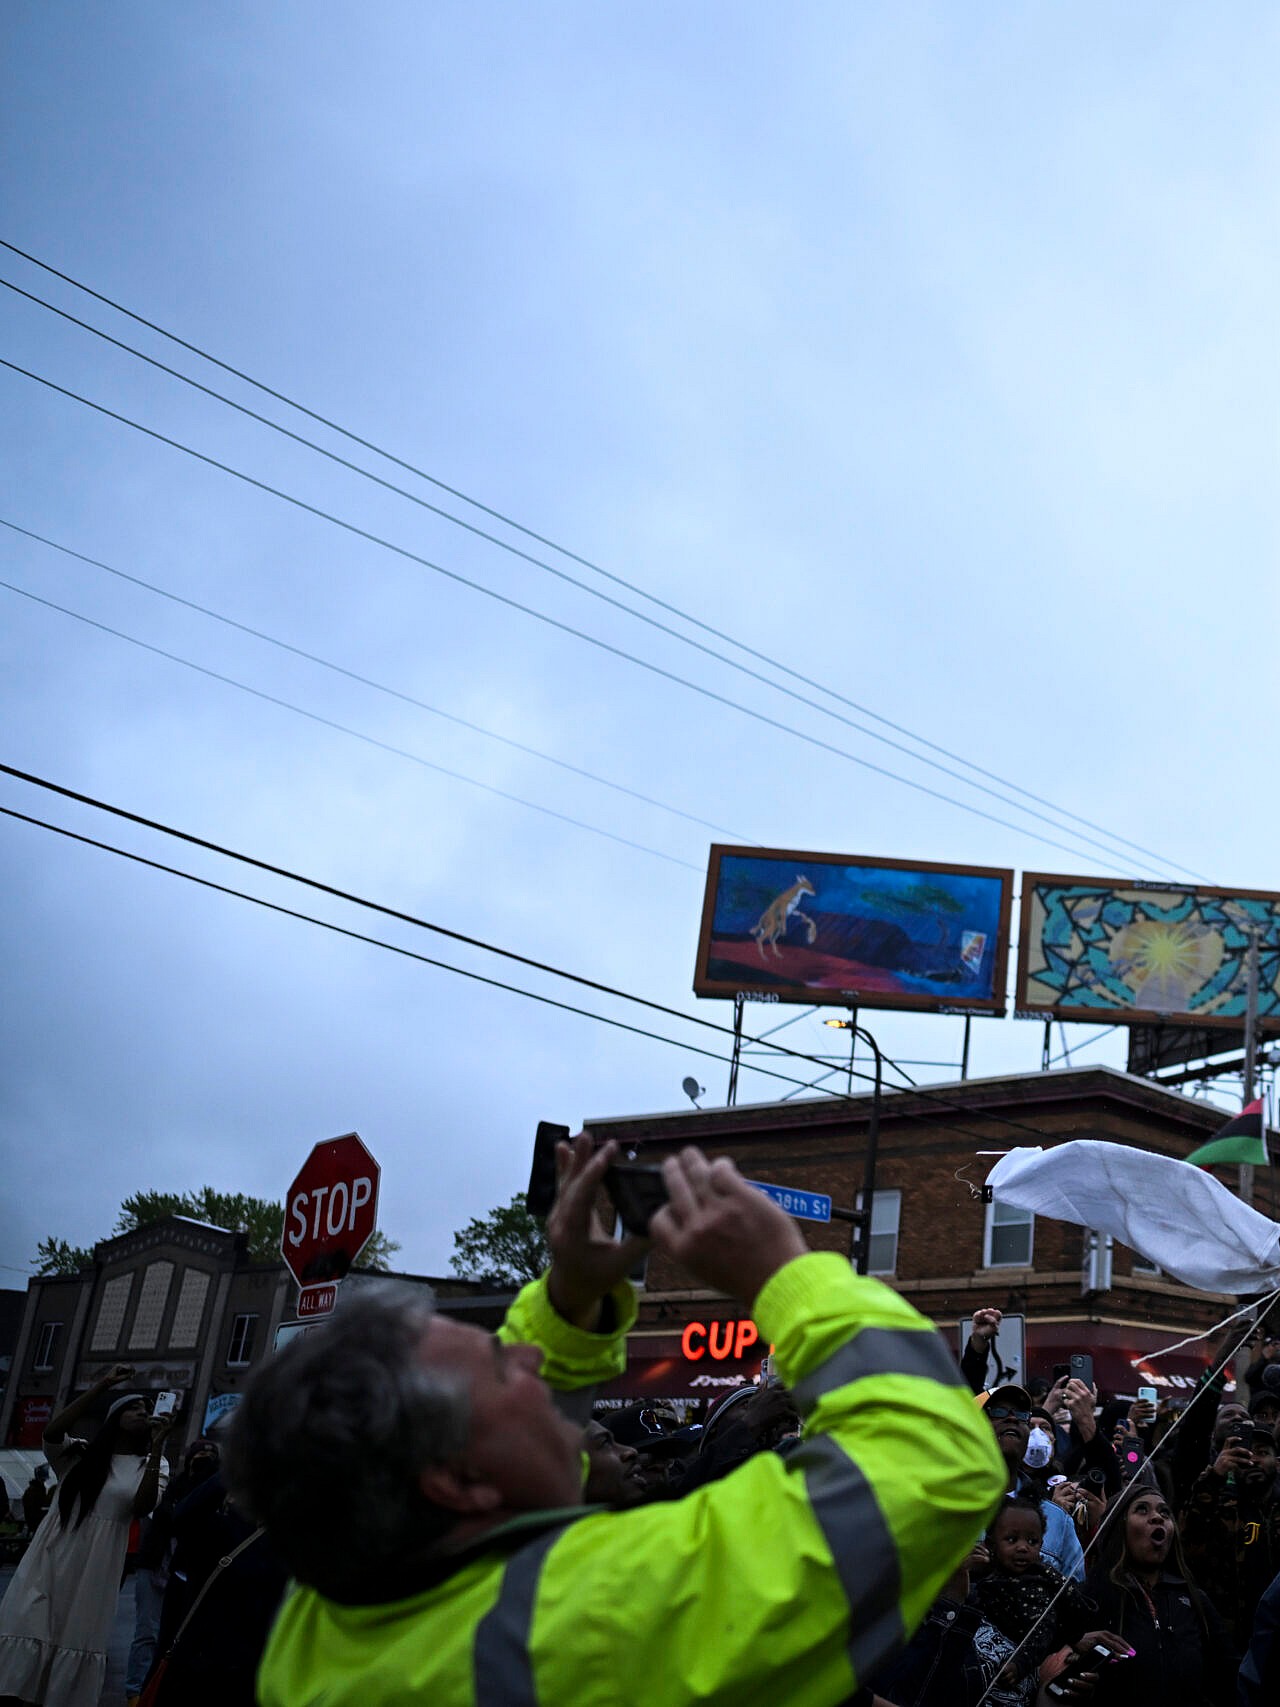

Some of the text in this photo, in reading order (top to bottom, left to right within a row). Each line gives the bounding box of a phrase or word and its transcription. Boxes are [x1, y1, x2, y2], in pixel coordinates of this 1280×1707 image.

[288, 1176, 372, 1248] STOP
[812, 1199, 828, 1217] St
[301, 1291, 334, 1311] ALL WAY
[681, 1320, 759, 1361] CUP
